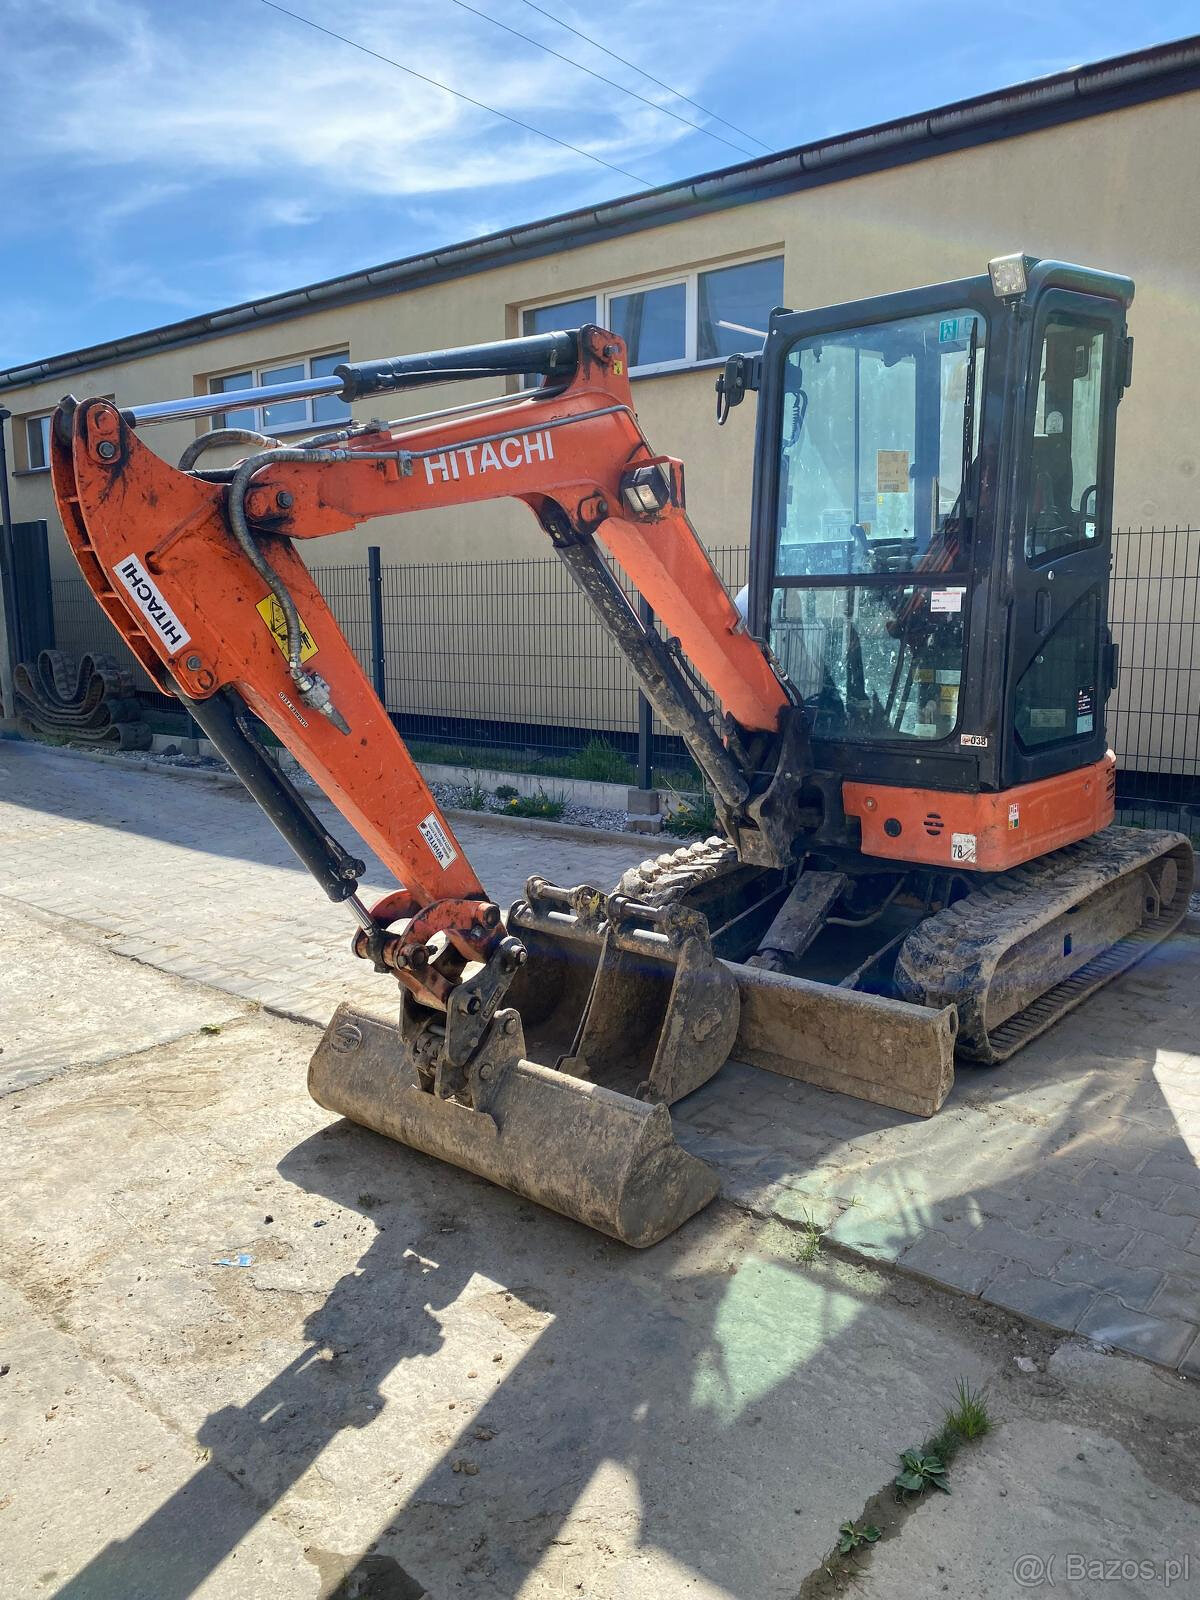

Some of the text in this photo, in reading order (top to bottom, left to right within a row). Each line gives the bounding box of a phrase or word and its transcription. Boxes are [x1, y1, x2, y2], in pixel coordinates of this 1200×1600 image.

[423, 431, 554, 485] HITACHI
[121, 562, 182, 646] HITACHI
[970, 736, 986, 746] 038
[425, 830, 443, 861] WHITES
[952, 844, 963, 859] 78
